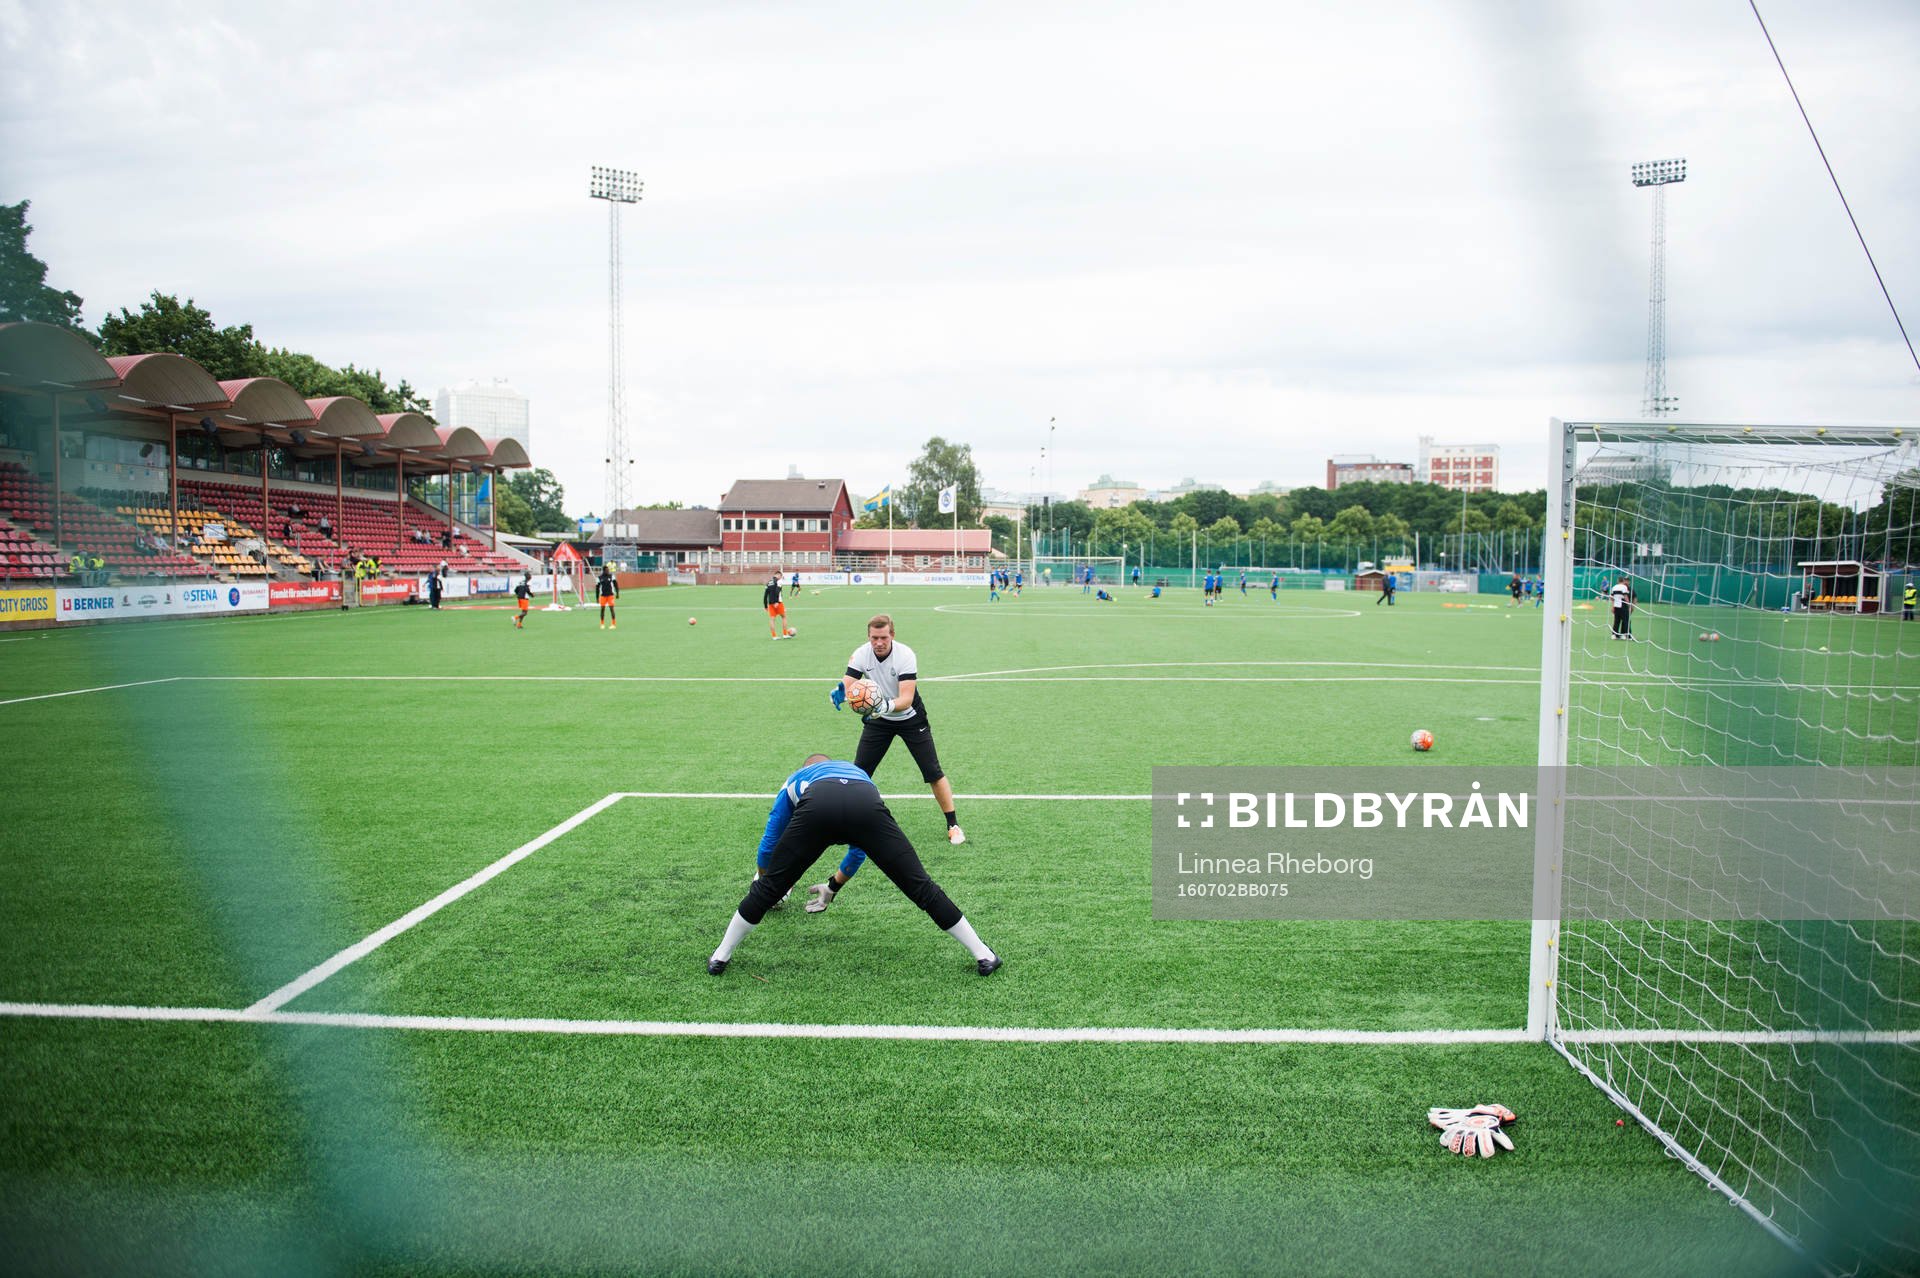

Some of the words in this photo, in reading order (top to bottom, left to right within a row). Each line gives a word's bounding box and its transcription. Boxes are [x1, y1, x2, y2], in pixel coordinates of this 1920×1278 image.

[191, 588, 218, 602] STENA
[0, 598, 18, 613] CITY
[20, 597, 48, 611] GROSS
[74, 597, 114, 611] BERNER
